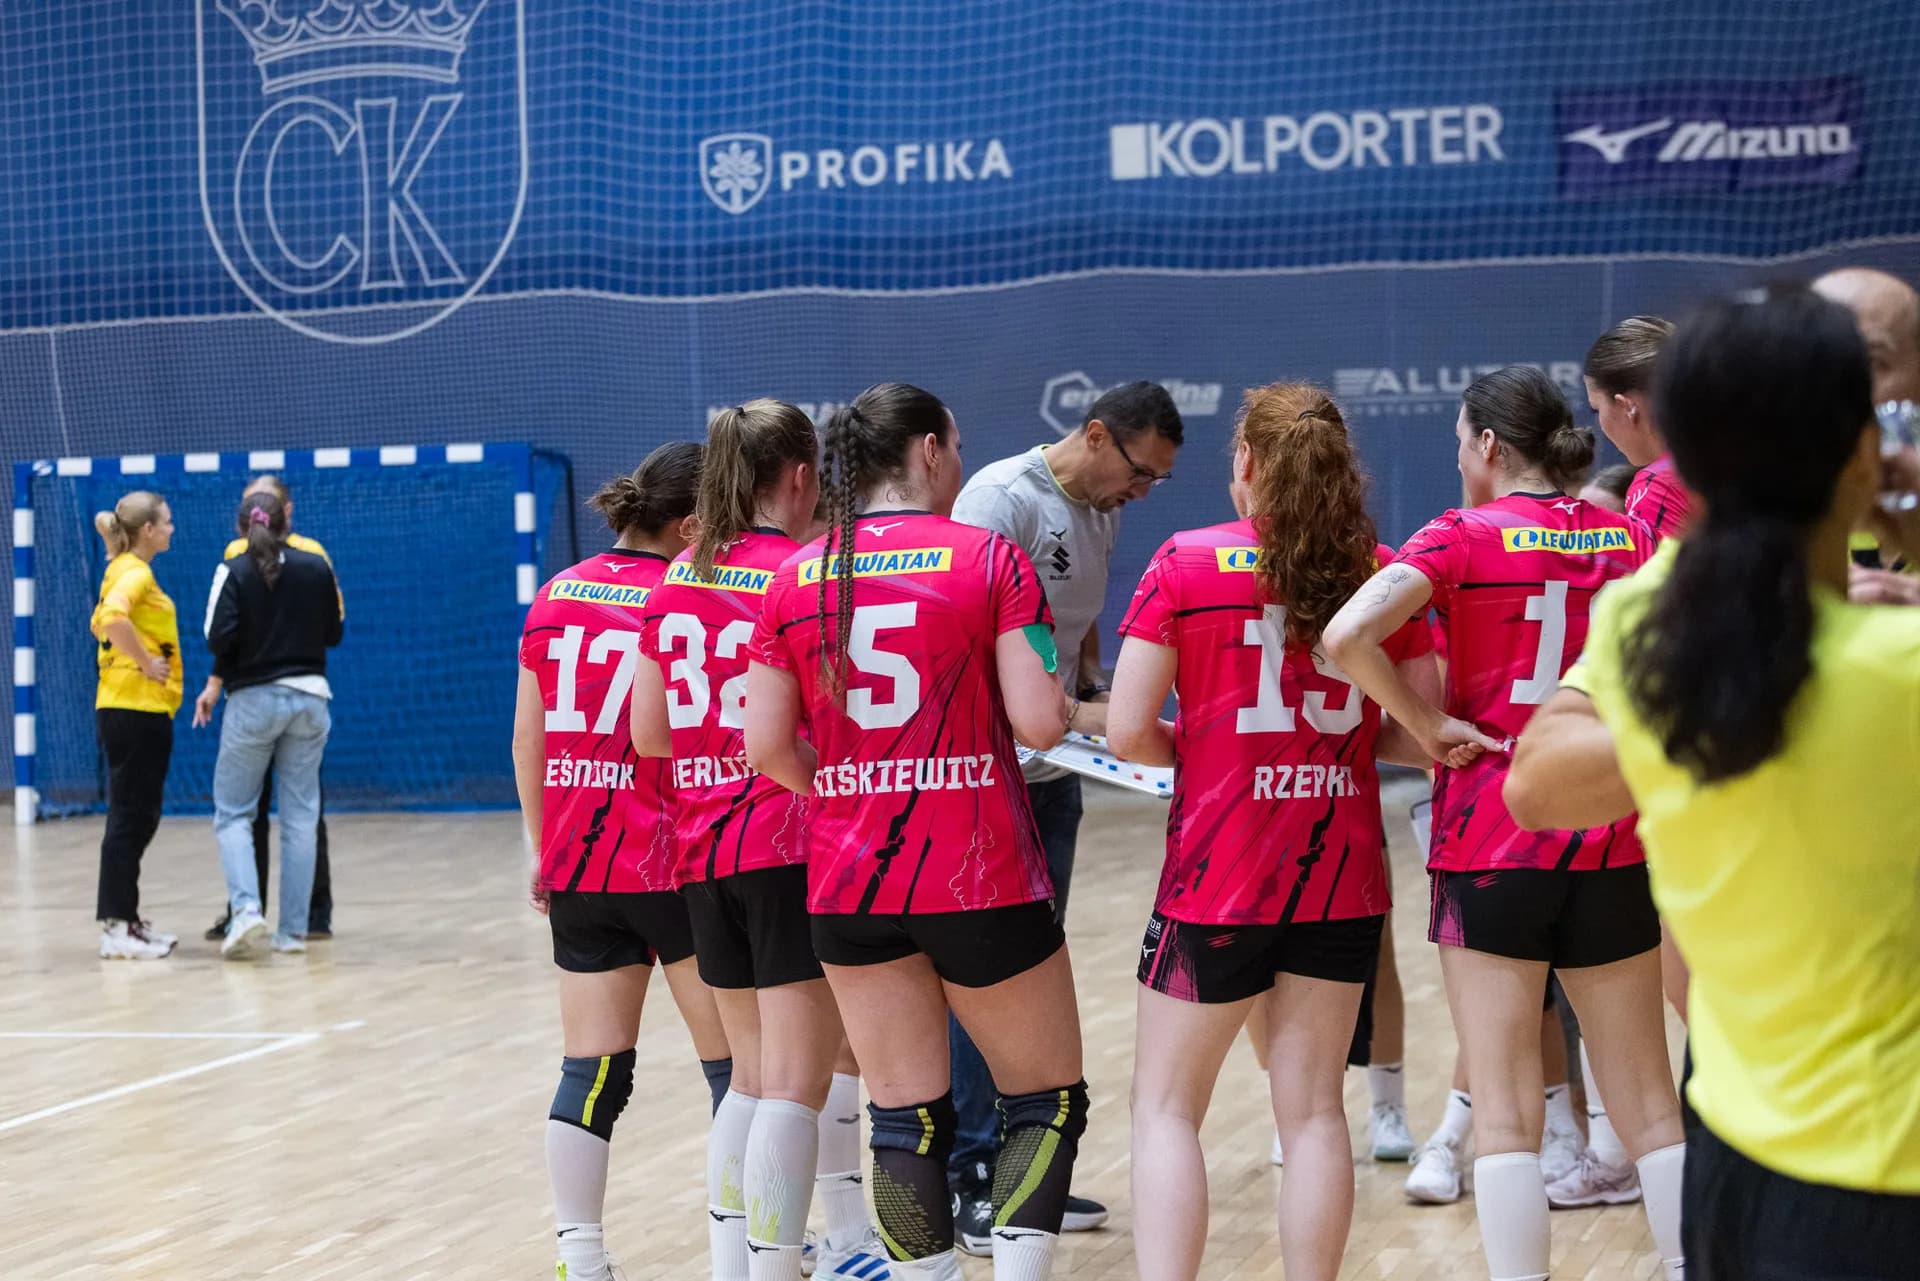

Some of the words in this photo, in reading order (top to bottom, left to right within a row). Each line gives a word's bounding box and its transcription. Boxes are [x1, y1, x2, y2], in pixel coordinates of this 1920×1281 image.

[779, 138, 1013, 191] PROFIKA
[1150, 104, 1505, 178] KOLPORTER
[234, 92, 467, 293] CK
[1541, 531, 1628, 550] LEWIATAN
[545, 625, 641, 735] 17
[658, 612, 754, 730] 32
[847, 601, 920, 730] 5
[544, 753, 635, 790] EŚNIAK
